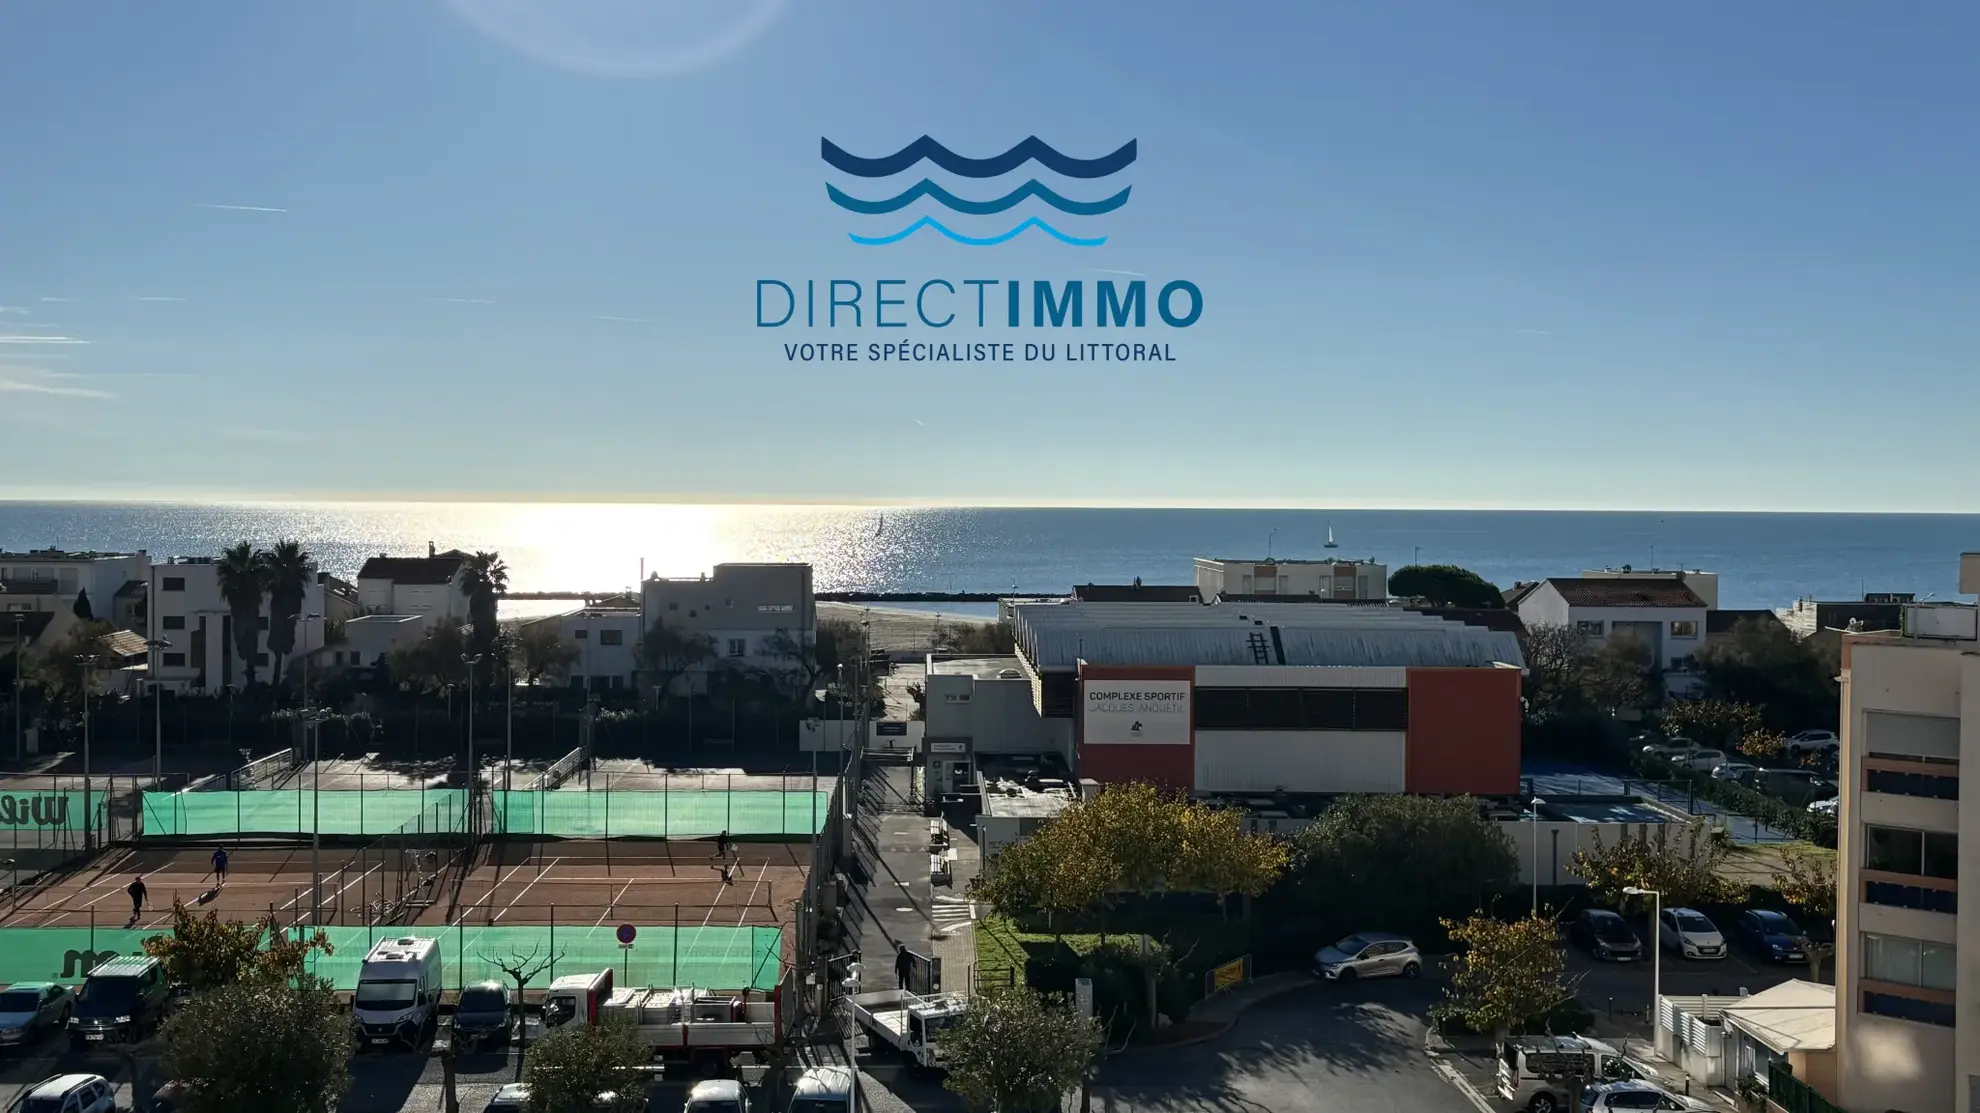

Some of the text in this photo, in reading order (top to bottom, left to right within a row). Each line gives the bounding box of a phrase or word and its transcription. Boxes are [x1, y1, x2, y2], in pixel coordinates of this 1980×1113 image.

[1089, 691, 1186, 701] COMPLEXE SPORTIF
[1090, 703, 1135, 713] JACQUES
